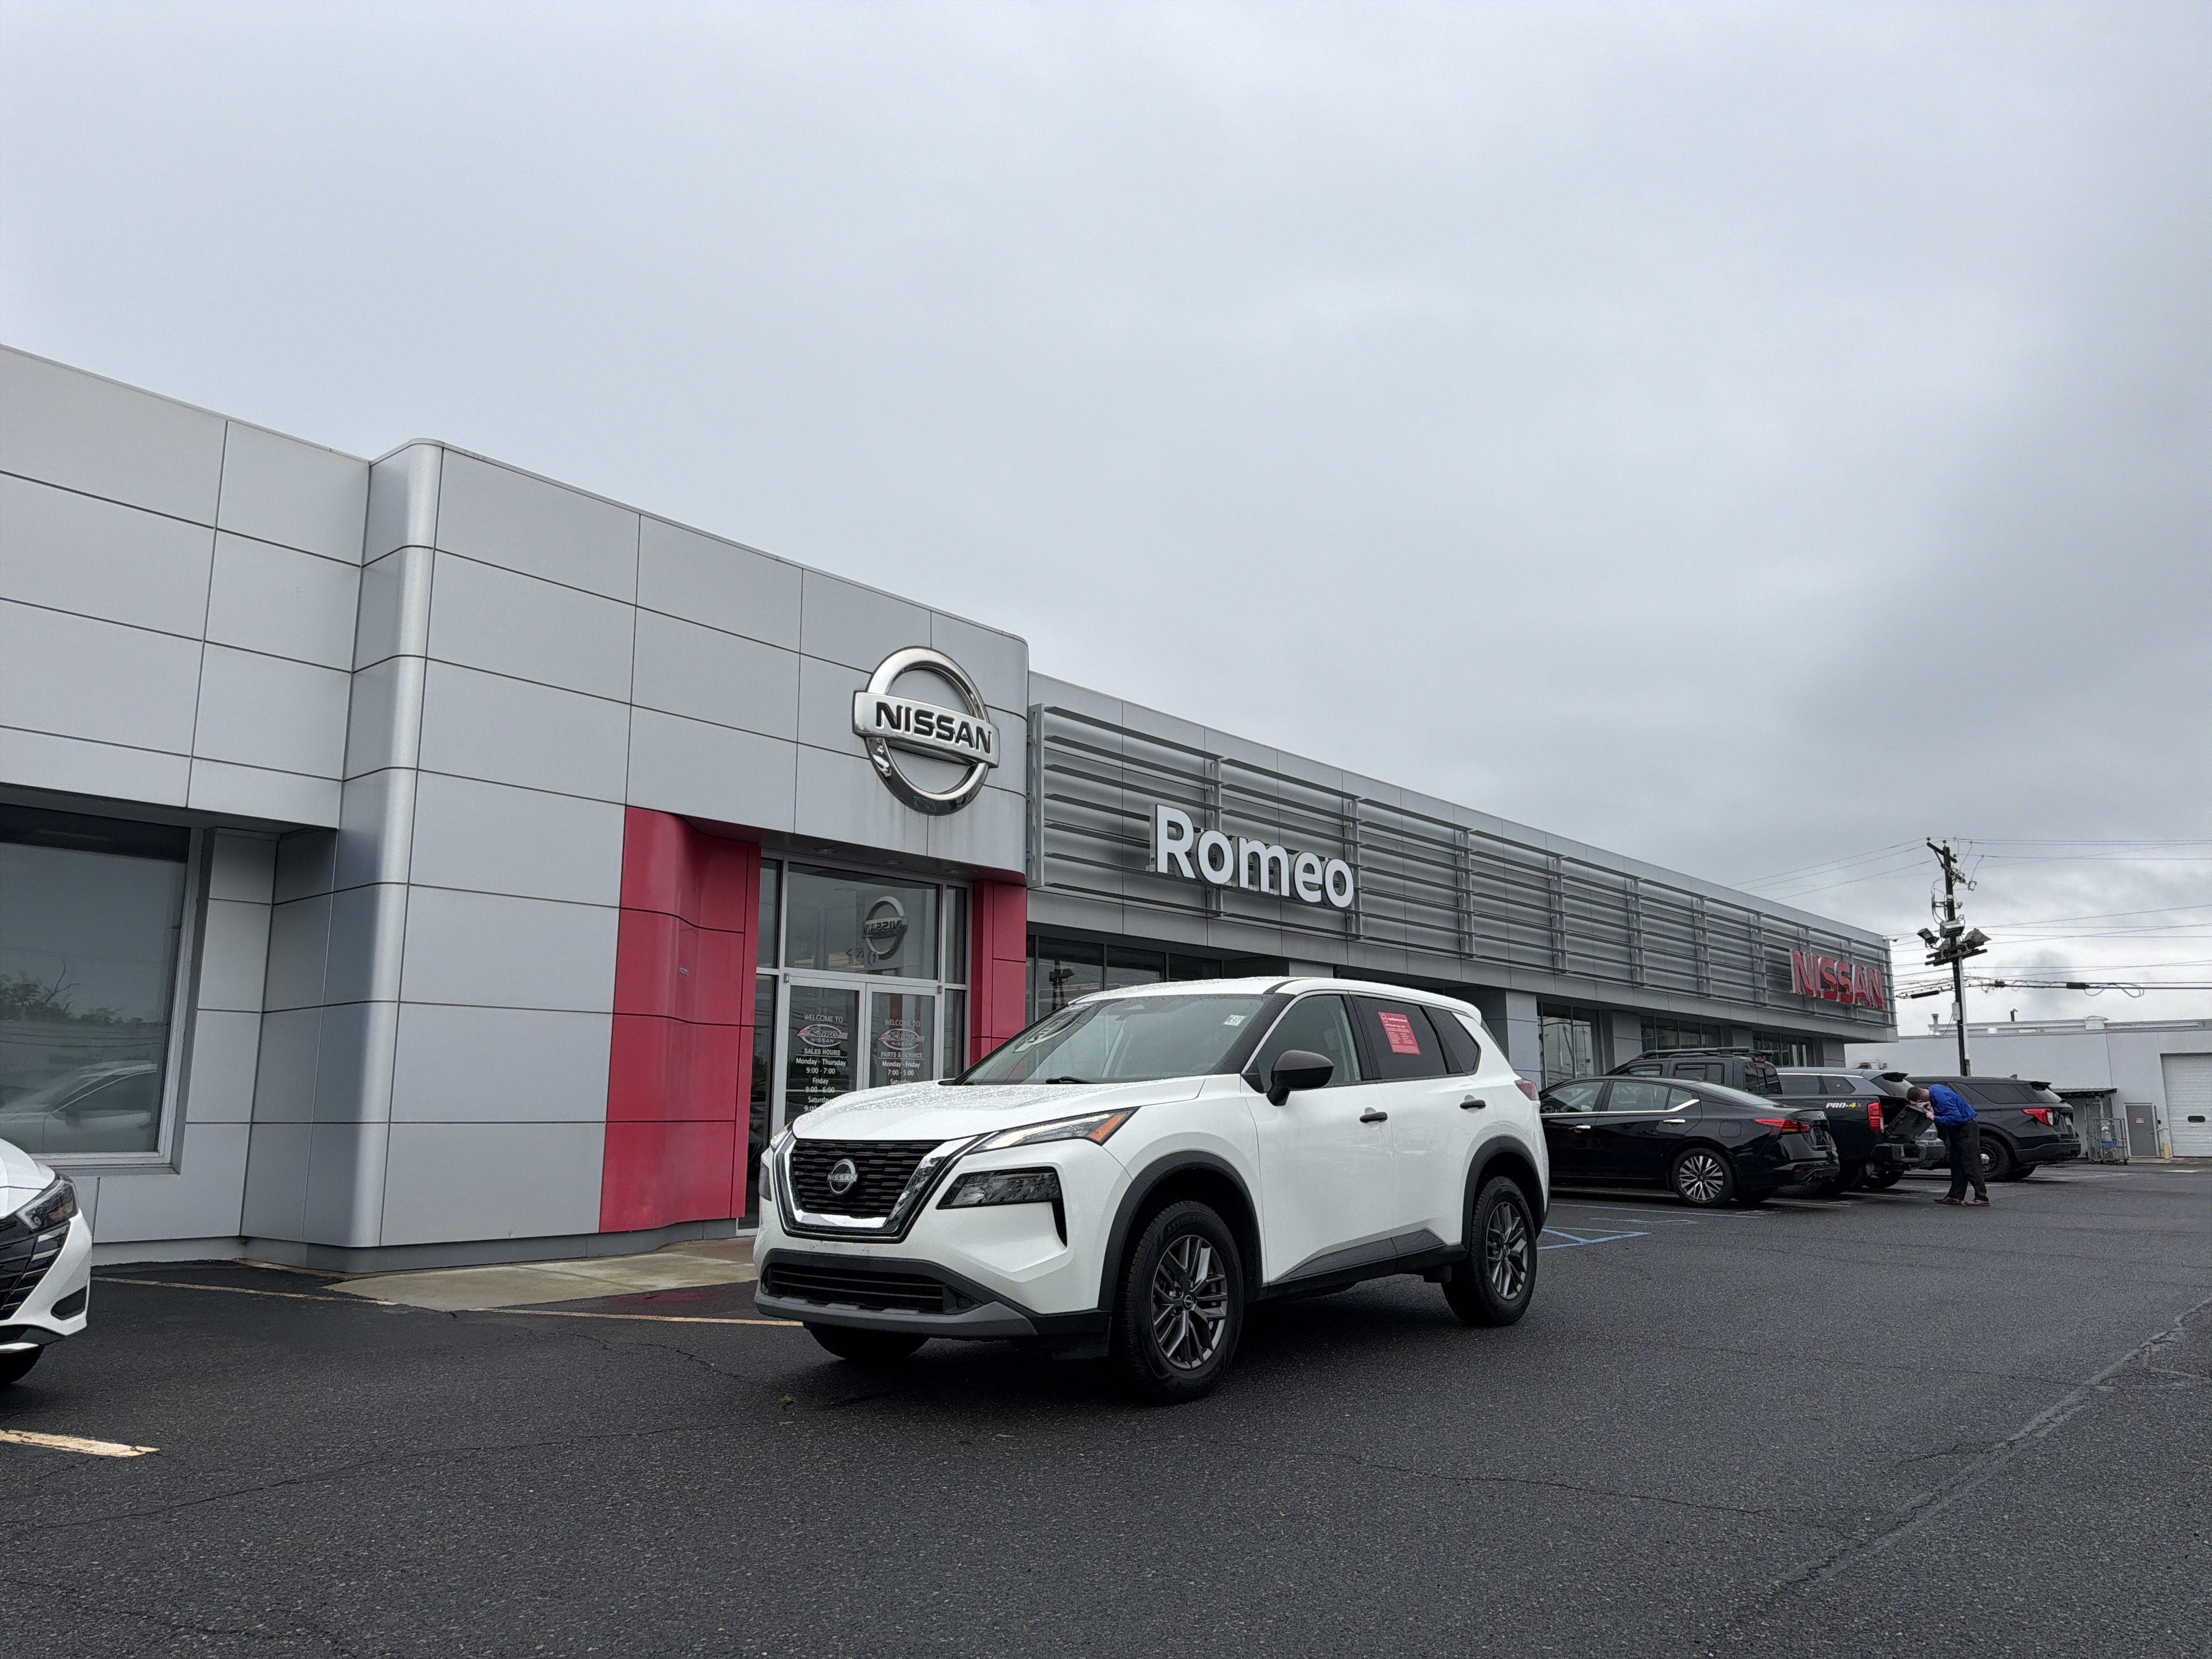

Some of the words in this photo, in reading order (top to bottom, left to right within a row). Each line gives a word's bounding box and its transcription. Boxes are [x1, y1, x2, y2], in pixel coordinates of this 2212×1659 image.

[875, 701, 992, 755] NISSAN
[1155, 804, 1355, 908] Romeo
[1792, 949, 1885, 1010] NISSAN
[804, 1014, 833, 1023] WELCOME
[884, 1019, 912, 1027] WELCOME
[807, 1025, 840, 1037] Romeo
[887, 1030, 918, 1041] Romeo
[795, 1058, 817, 1066] Monday
[822, 1058, 846, 1067] Thursday
